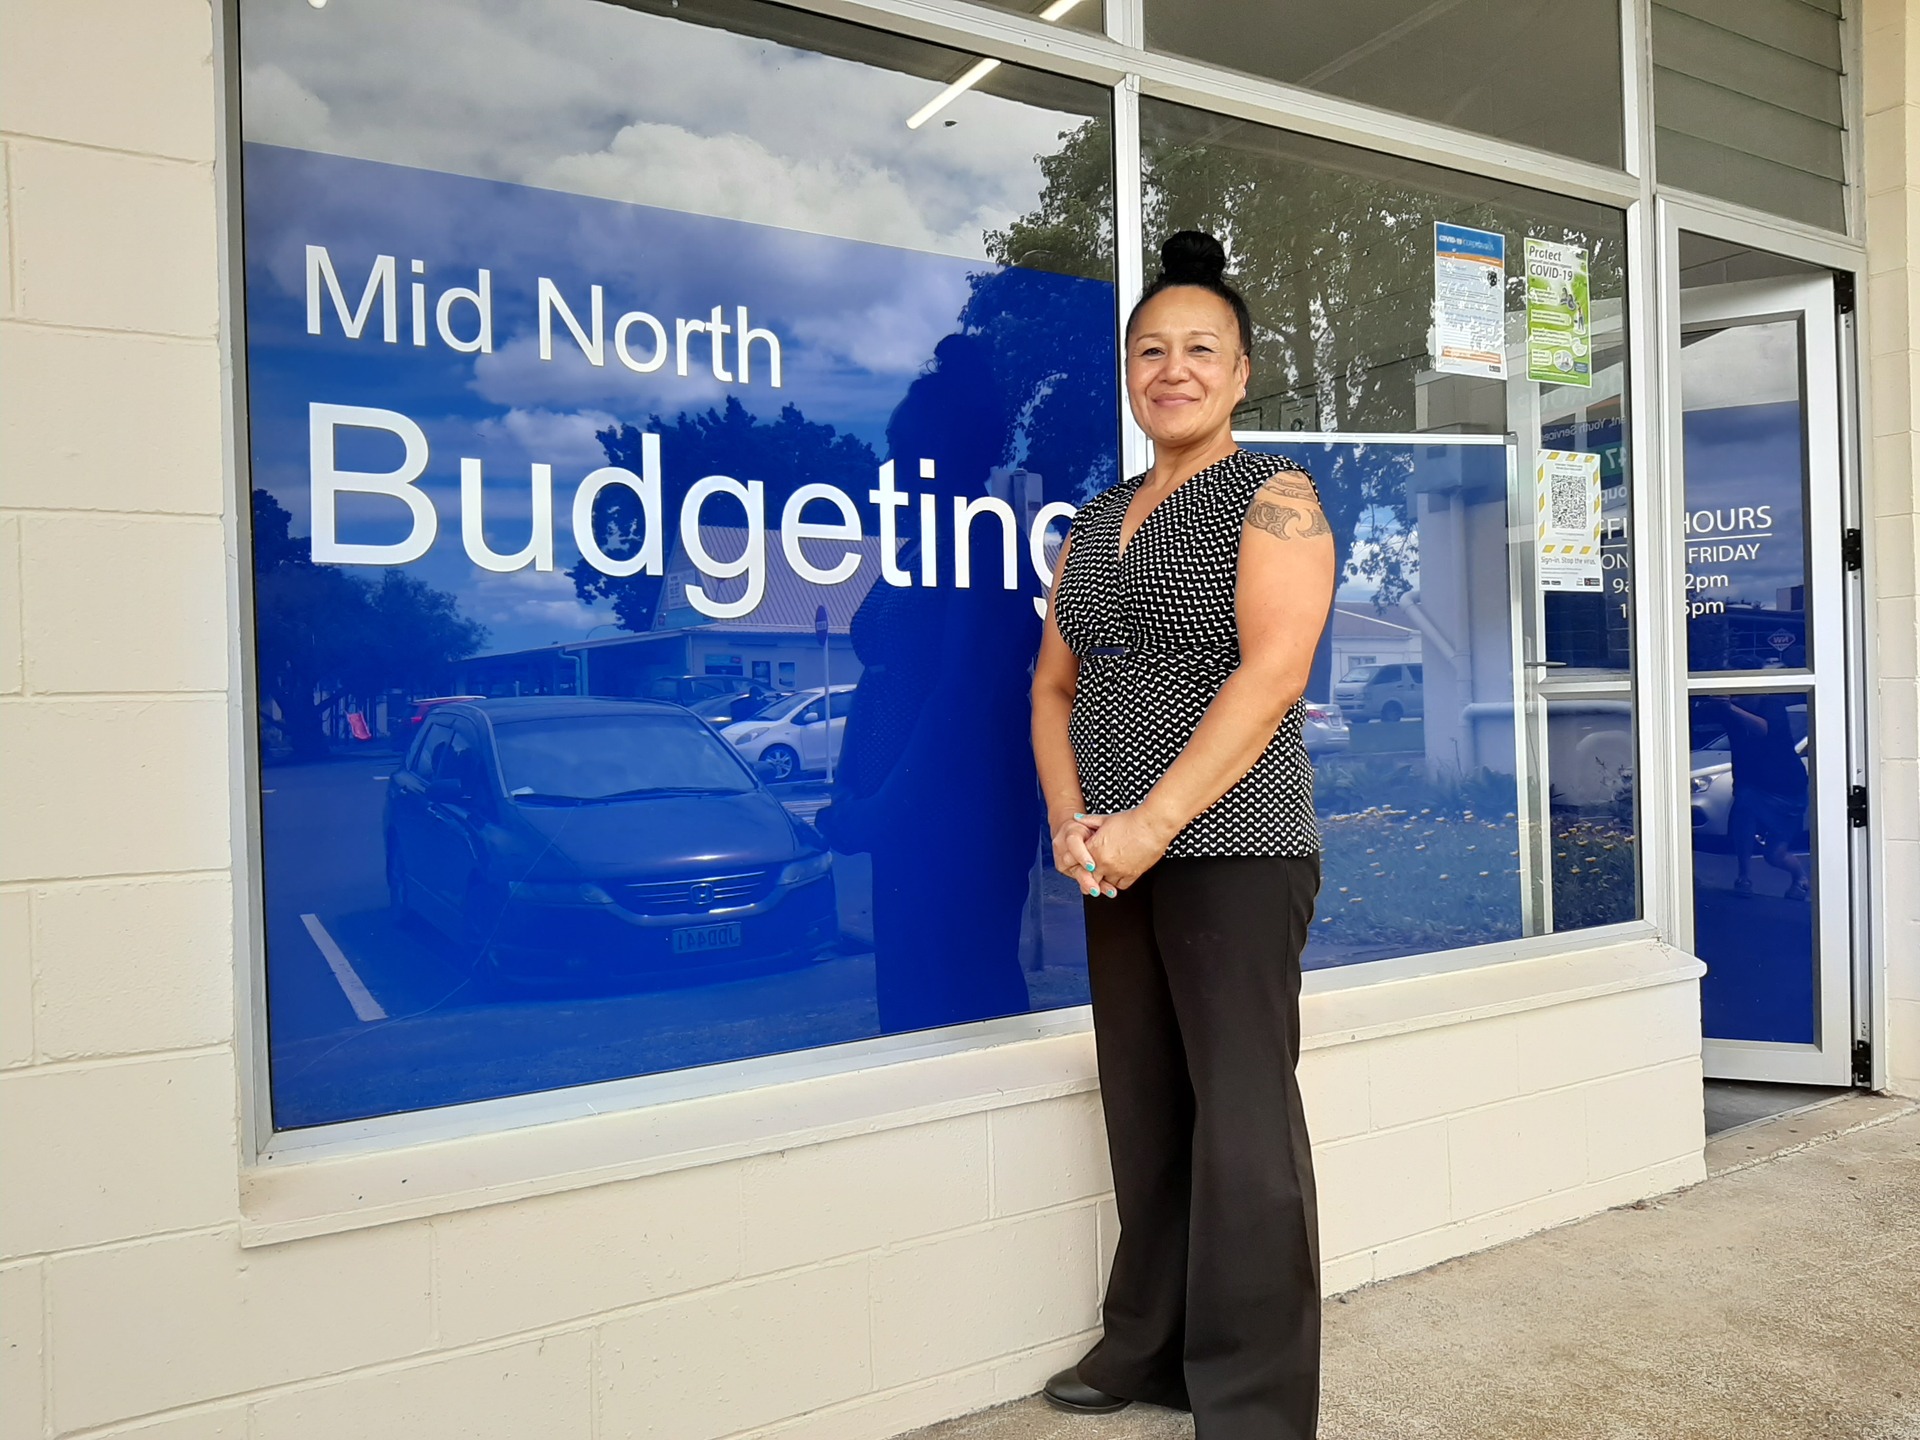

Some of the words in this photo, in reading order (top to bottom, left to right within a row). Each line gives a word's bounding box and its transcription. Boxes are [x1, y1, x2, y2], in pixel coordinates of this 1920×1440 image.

[1528, 245, 1562, 262] Protect
[1530, 263, 1573, 281] COVID-19
[303, 243, 493, 354] Mid
[538, 276, 783, 389] North
[1688, 543, 1760, 564] FRIDAY
[1684, 573, 1729, 593] 2pm
